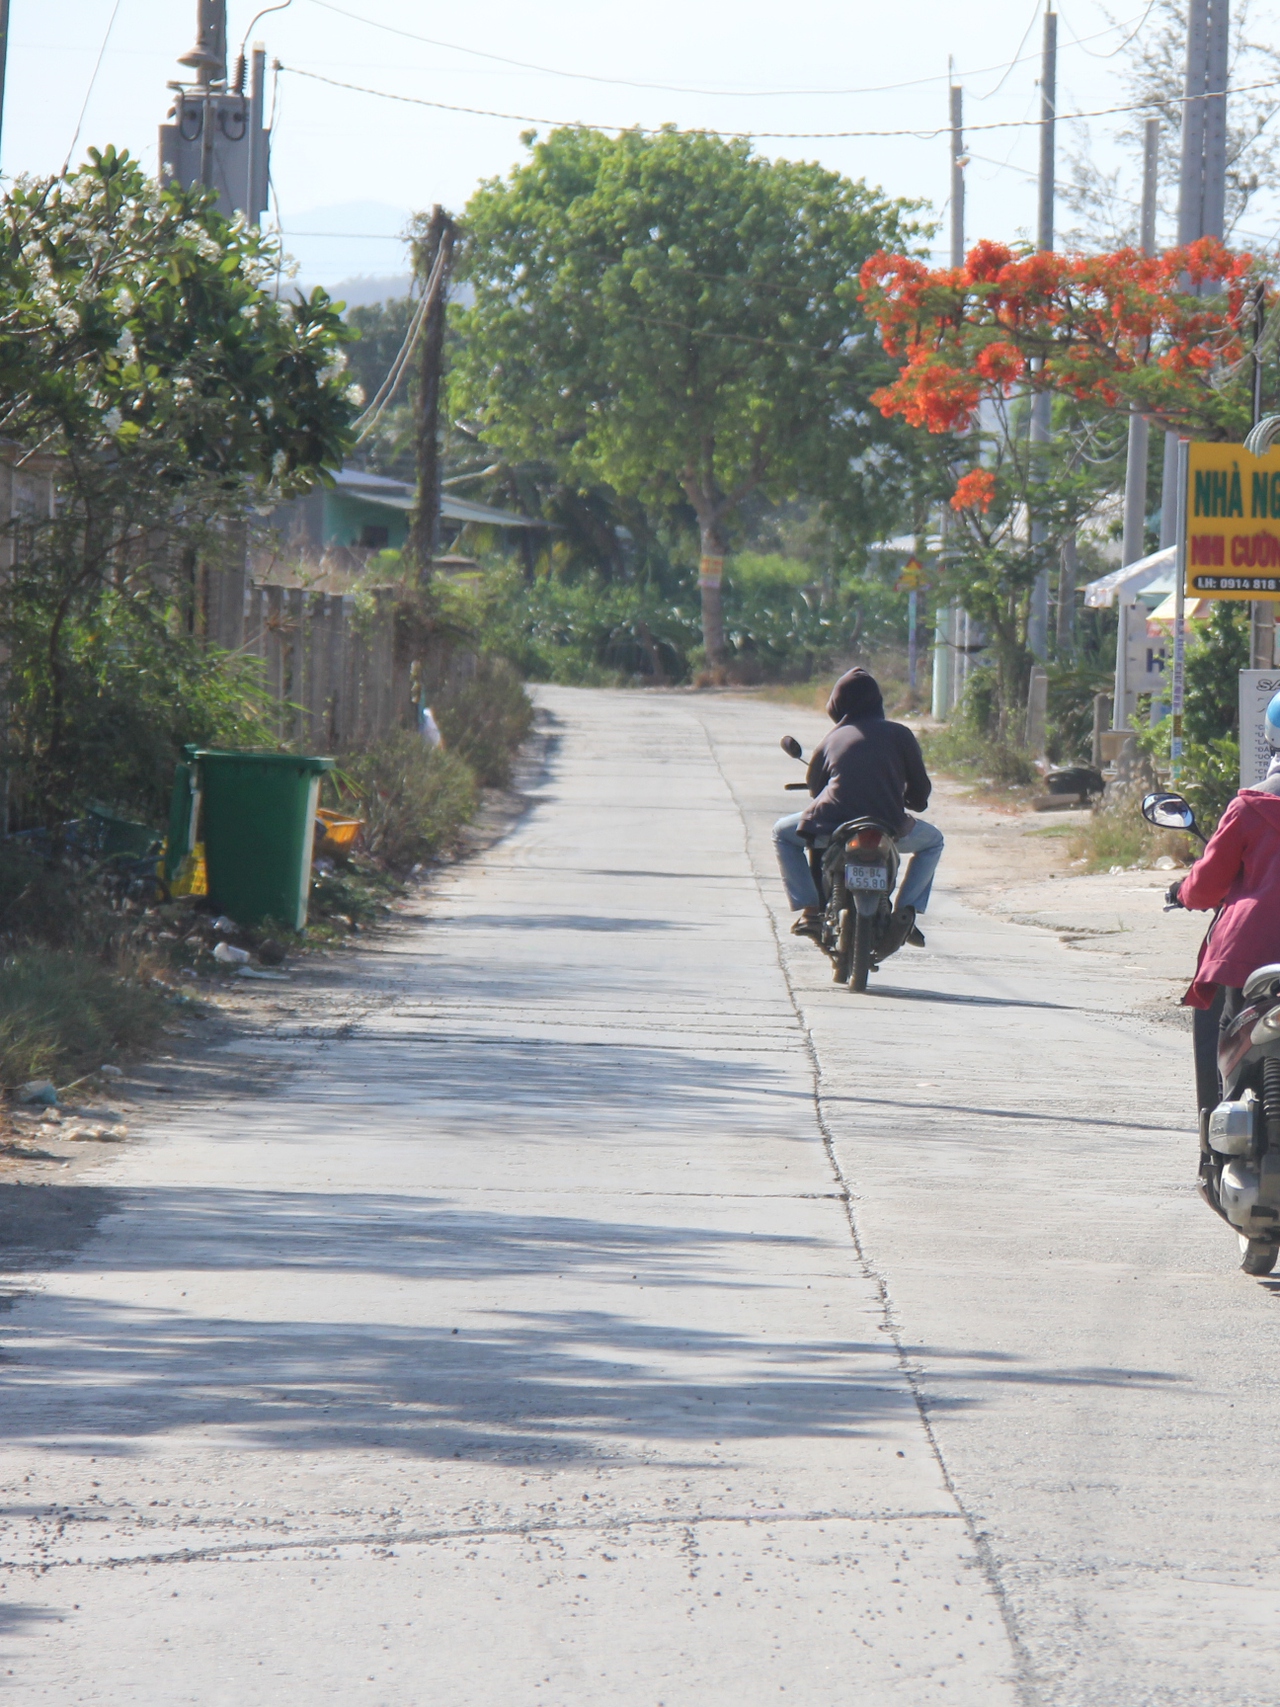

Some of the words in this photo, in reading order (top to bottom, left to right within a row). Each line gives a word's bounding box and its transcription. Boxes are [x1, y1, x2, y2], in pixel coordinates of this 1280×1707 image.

[1194, 461, 1244, 518] NHÀ
[1191, 534, 1225, 567] NHI
[1197, 577, 1217, 588] LH:
[1220, 577, 1250, 589] 0914
[1253, 578, 1276, 590] 818
